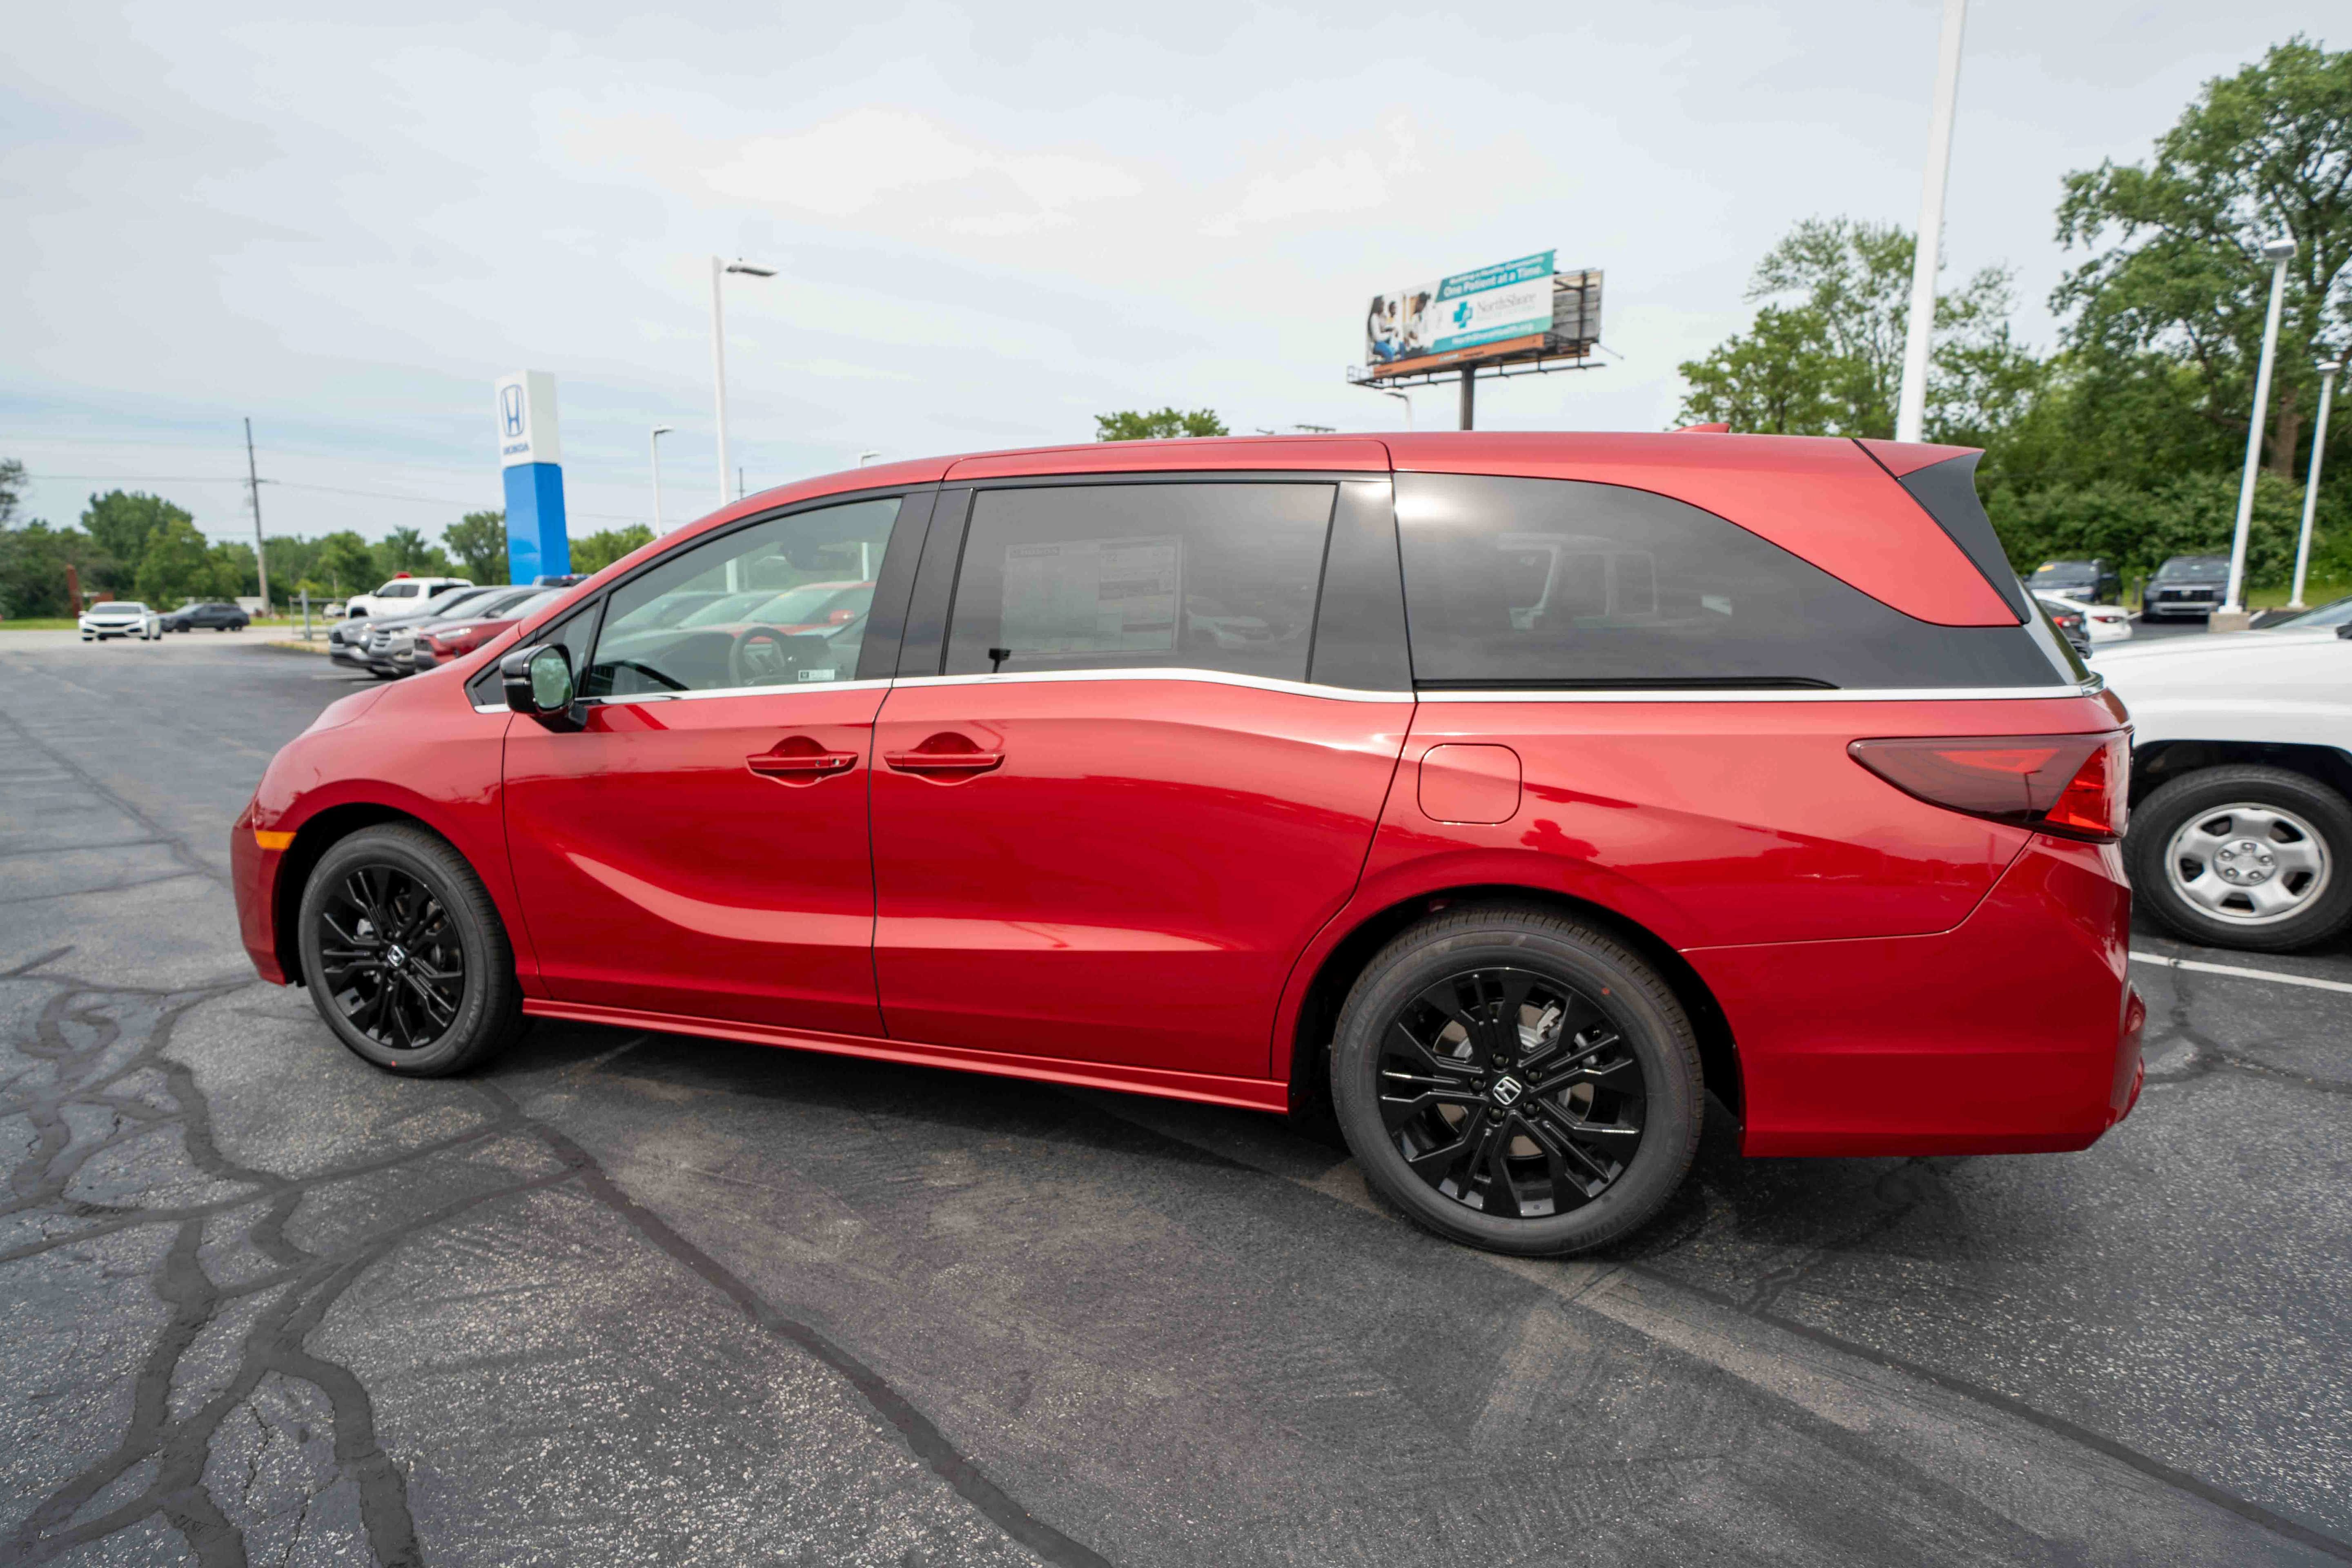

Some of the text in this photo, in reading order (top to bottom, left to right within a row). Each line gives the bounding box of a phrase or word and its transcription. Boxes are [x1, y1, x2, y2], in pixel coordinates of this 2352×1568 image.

[1443, 285, 1462, 297] One
[1463, 275, 1496, 292] Patient
[1497, 273, 1508, 283] at
[1508, 272, 1516, 281] a
[503, 441, 529, 456] HONDA
